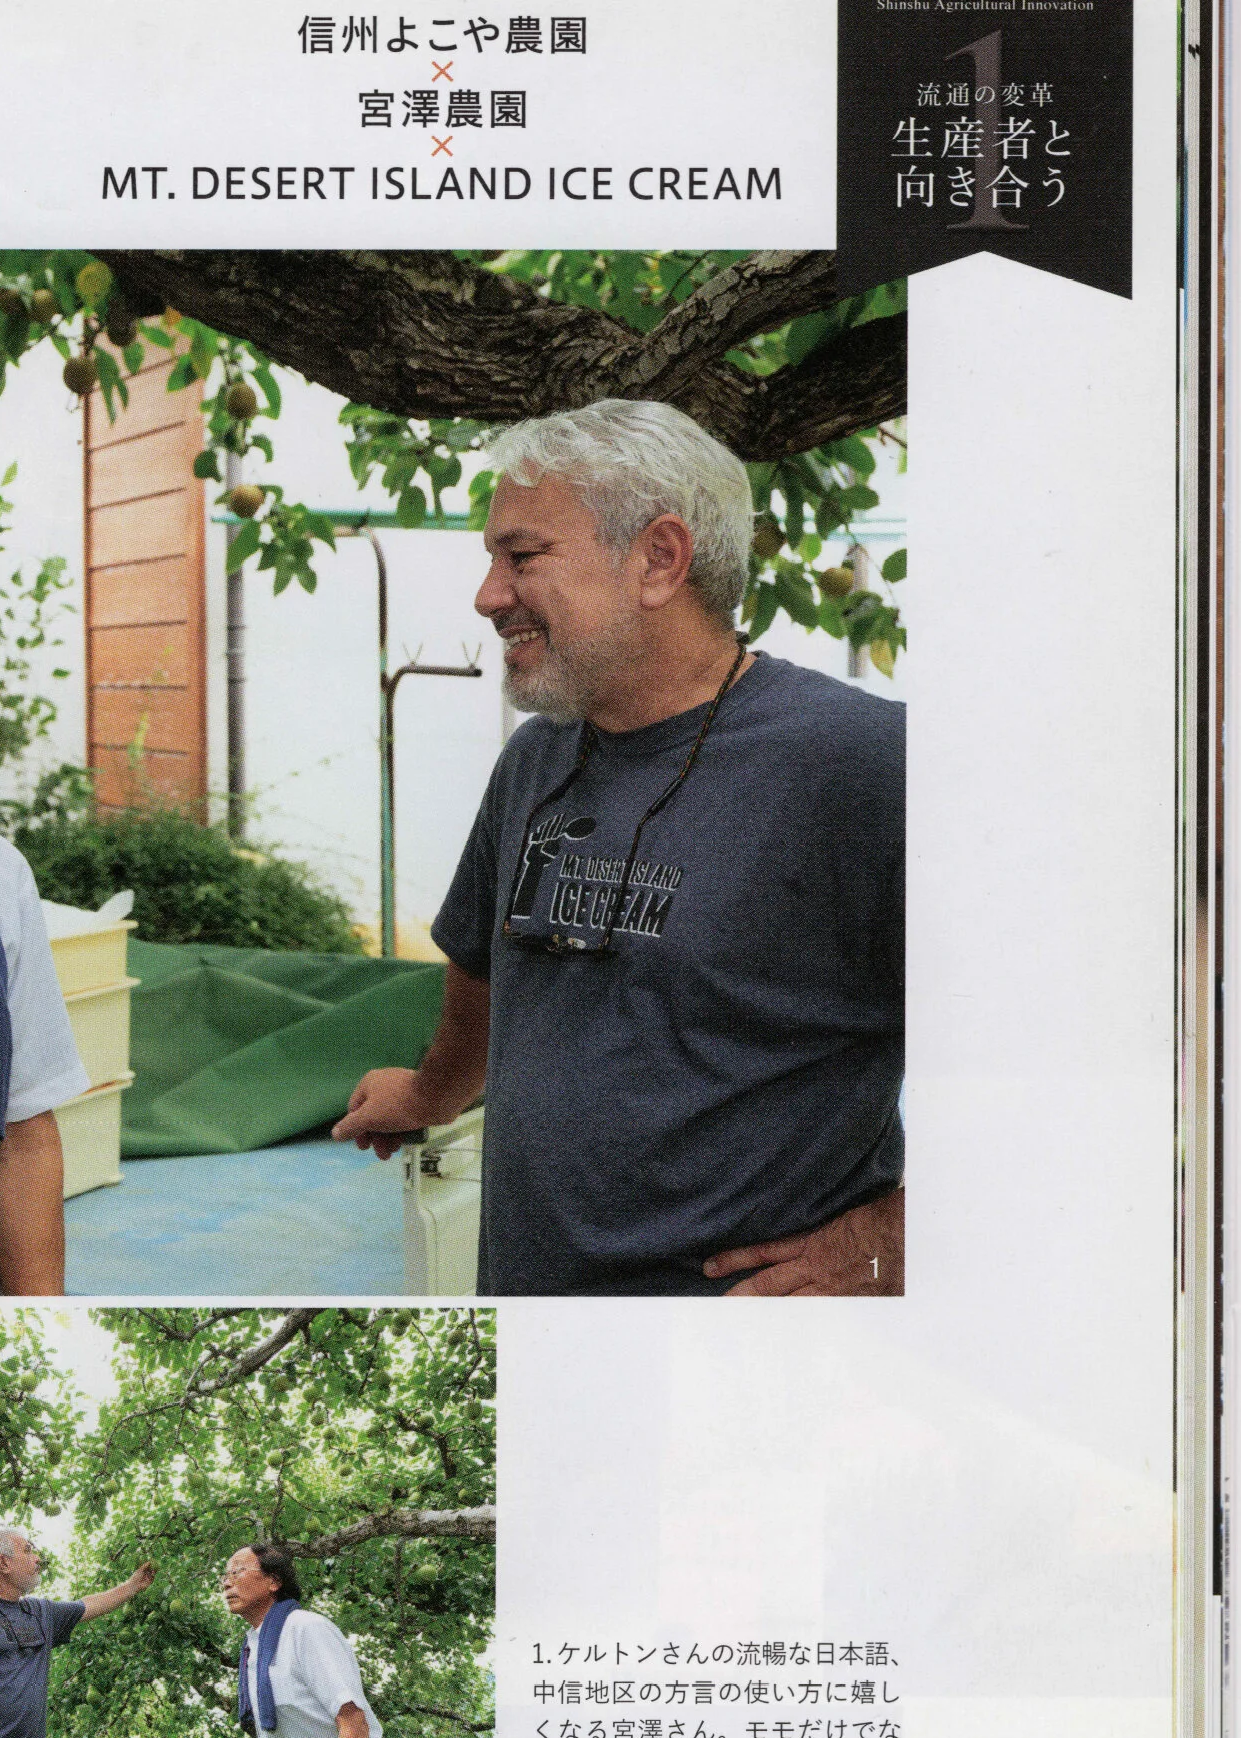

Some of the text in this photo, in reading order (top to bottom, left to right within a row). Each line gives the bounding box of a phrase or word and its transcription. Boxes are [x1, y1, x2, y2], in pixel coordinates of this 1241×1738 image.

[876, 0, 1094, 13] Shinshu Agricultural Innovation
[297, 15, 587, 55] 信州よこや農園
[358, 88, 527, 129] 宮澤農園
[916, 82, 1055, 108] 流通の変革
[890, 115, 1071, 160] 生産者と
[102, 166, 782, 201] MT. DESERT ISLAND ICE CREAM
[896, 165, 1066, 209] 向き合う
[549, 880, 592, 928] ICE
[868, 1256, 878, 1279] 1
[533, 1679, 900, 1705] 中信地区の方言の使い方に嬉し
